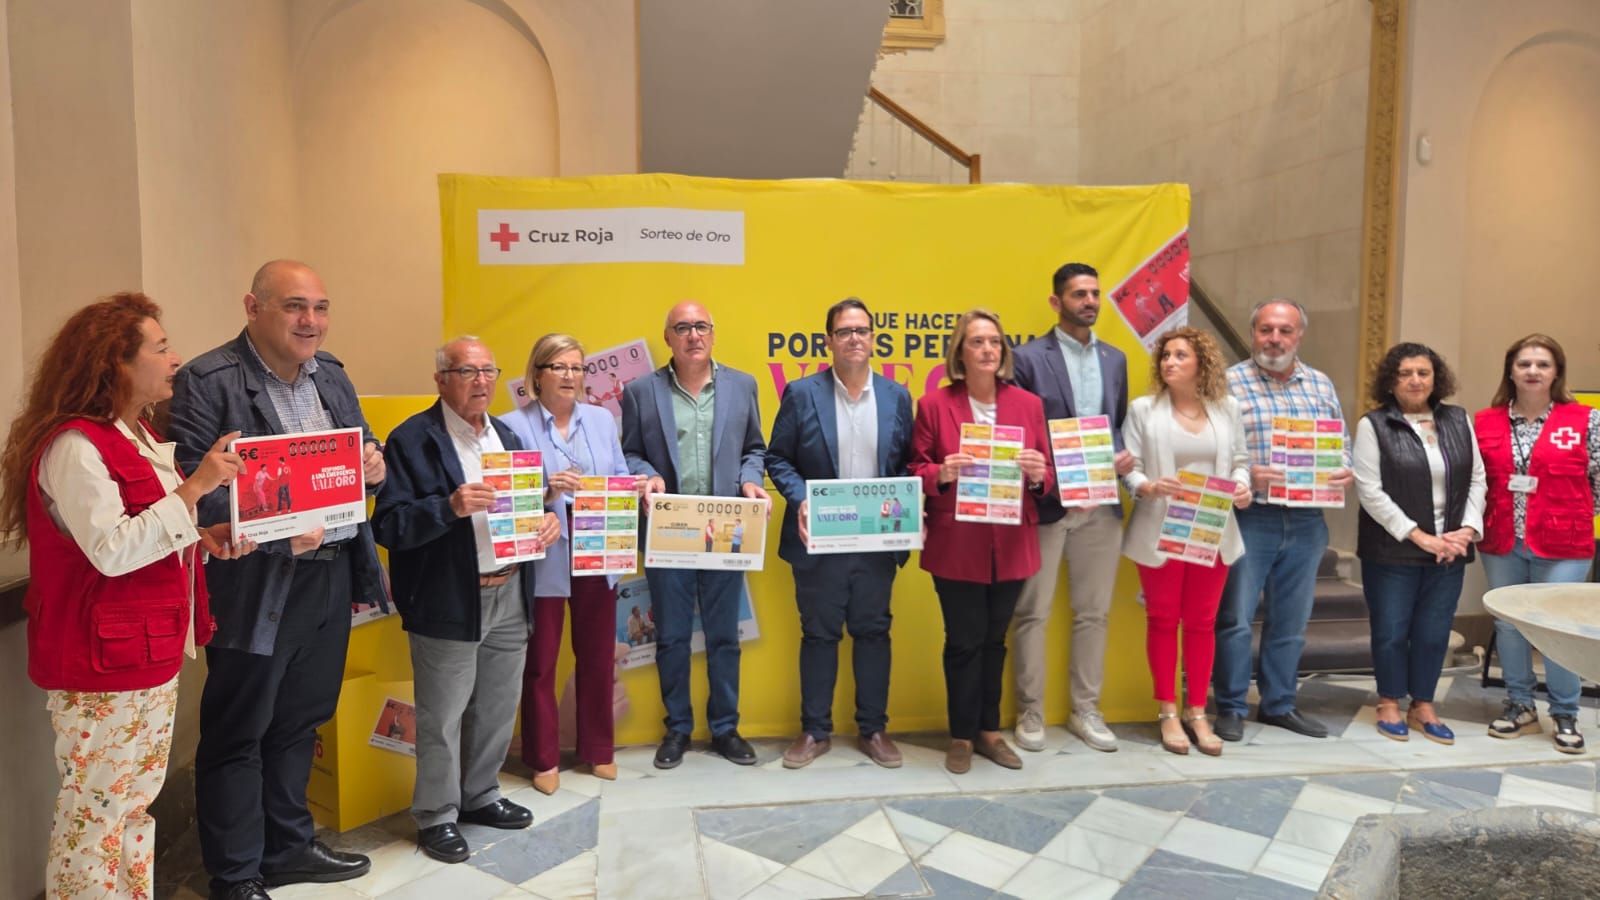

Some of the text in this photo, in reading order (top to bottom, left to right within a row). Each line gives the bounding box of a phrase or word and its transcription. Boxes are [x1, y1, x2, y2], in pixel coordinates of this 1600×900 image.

[528, 227, 614, 245] Cruz Roja
[640, 228, 731, 243] Sorteo de Oro
[872, 312, 899, 329] UE
[768, 332, 828, 358] POR
[586, 348, 639, 375] 000 0
[239, 448, 258, 461] 6€
[348, 436, 354, 447] 0
[812, 487, 829, 497] 6€
[654, 501, 672, 511] 6€
[752, 504, 760, 514] 0
